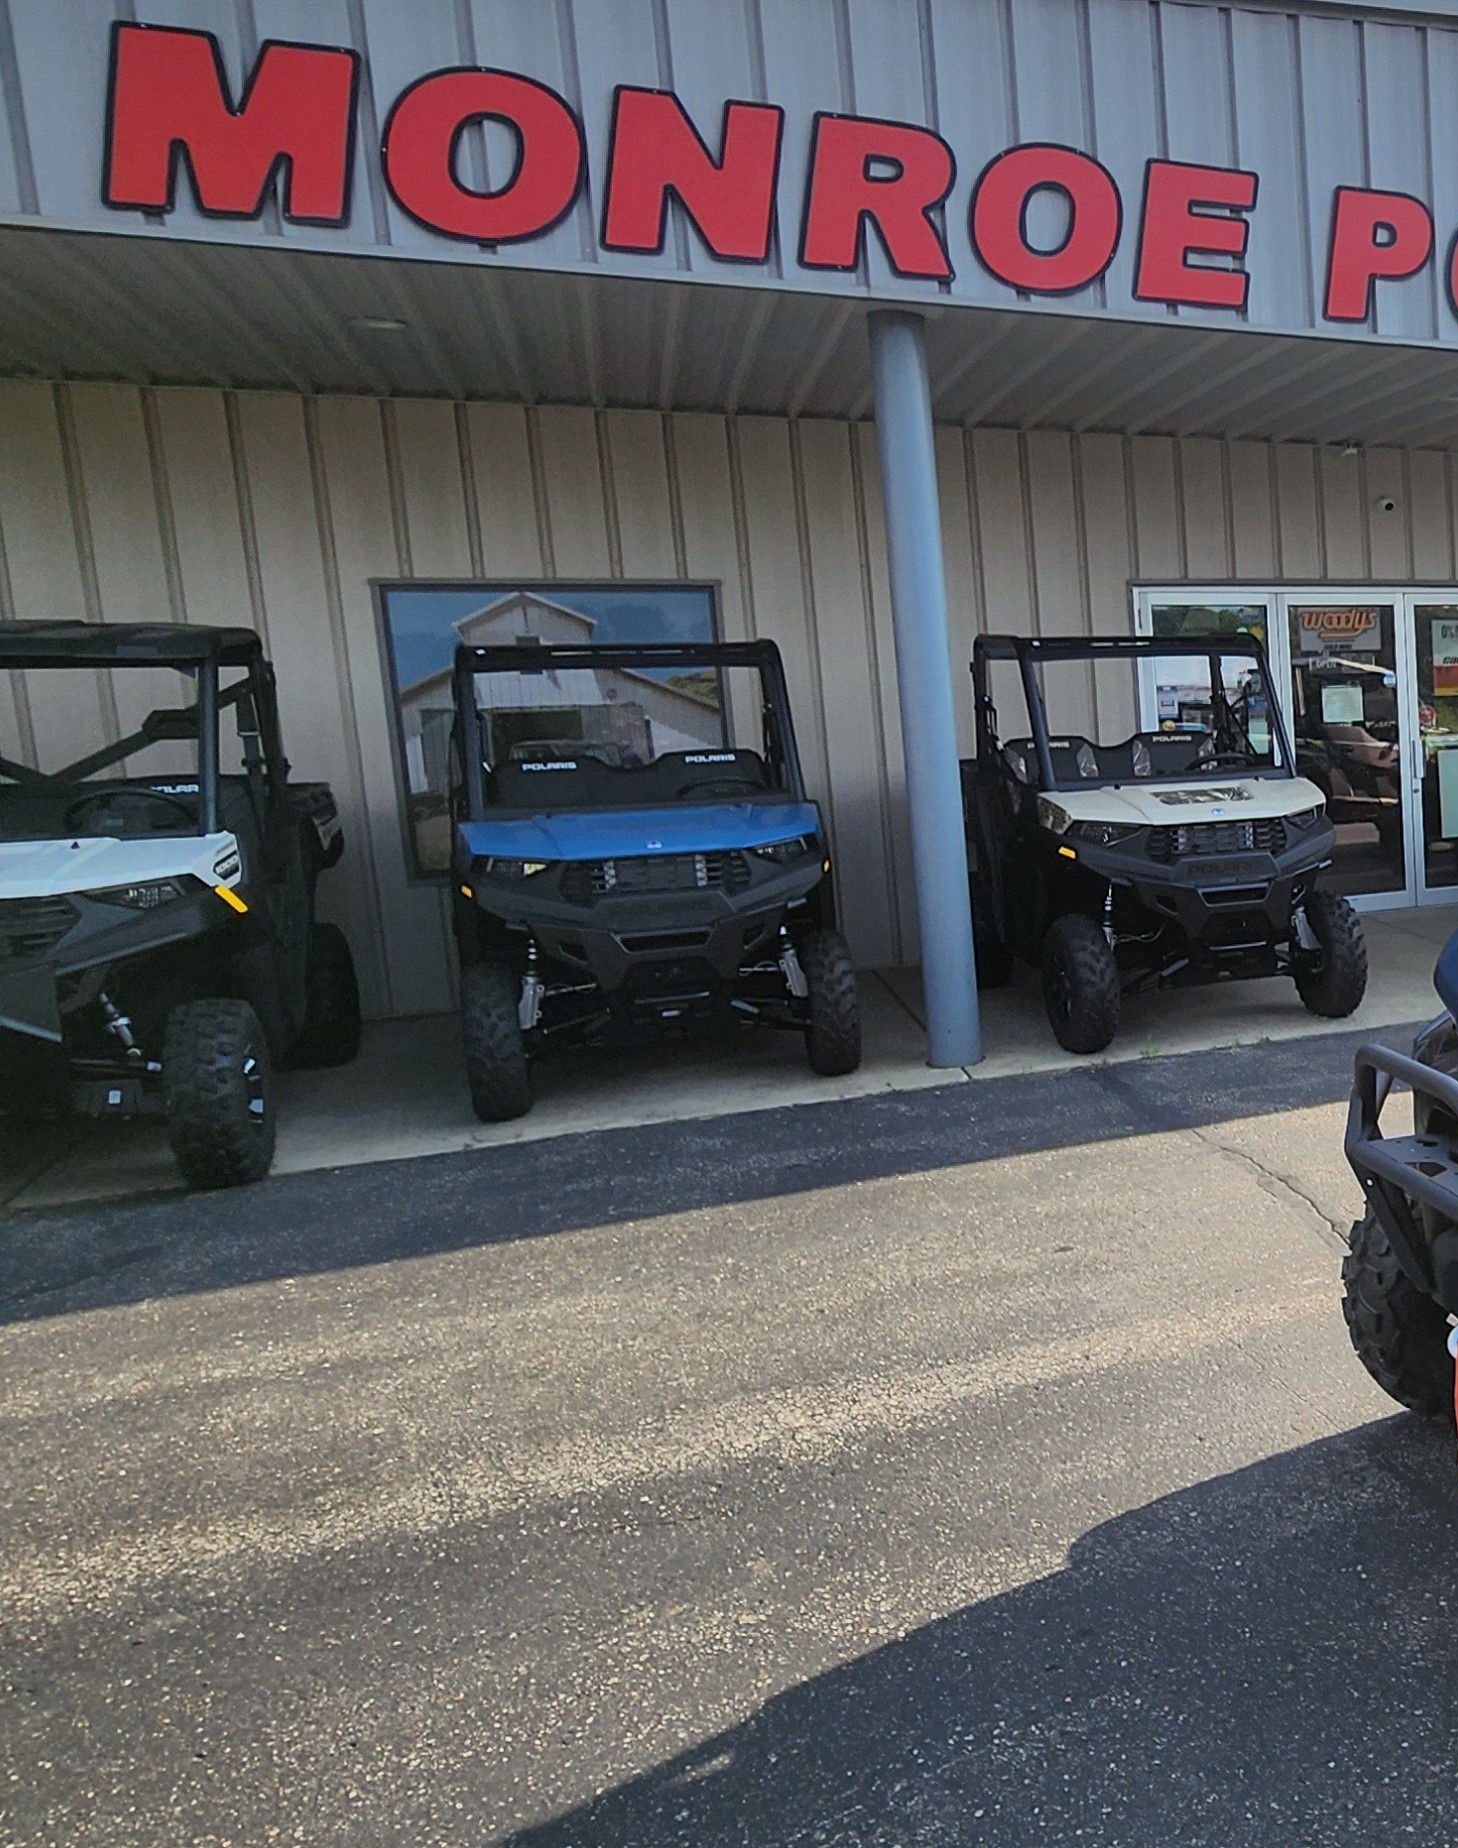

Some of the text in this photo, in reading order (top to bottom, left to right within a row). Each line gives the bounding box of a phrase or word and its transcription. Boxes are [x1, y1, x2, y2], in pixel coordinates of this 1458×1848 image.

[101, 20, 1258, 308] MONROE
[1301, 608, 1377, 638] woody's
[522, 762, 577, 771] POLARIS
[685, 754, 736, 763] POLARIS
